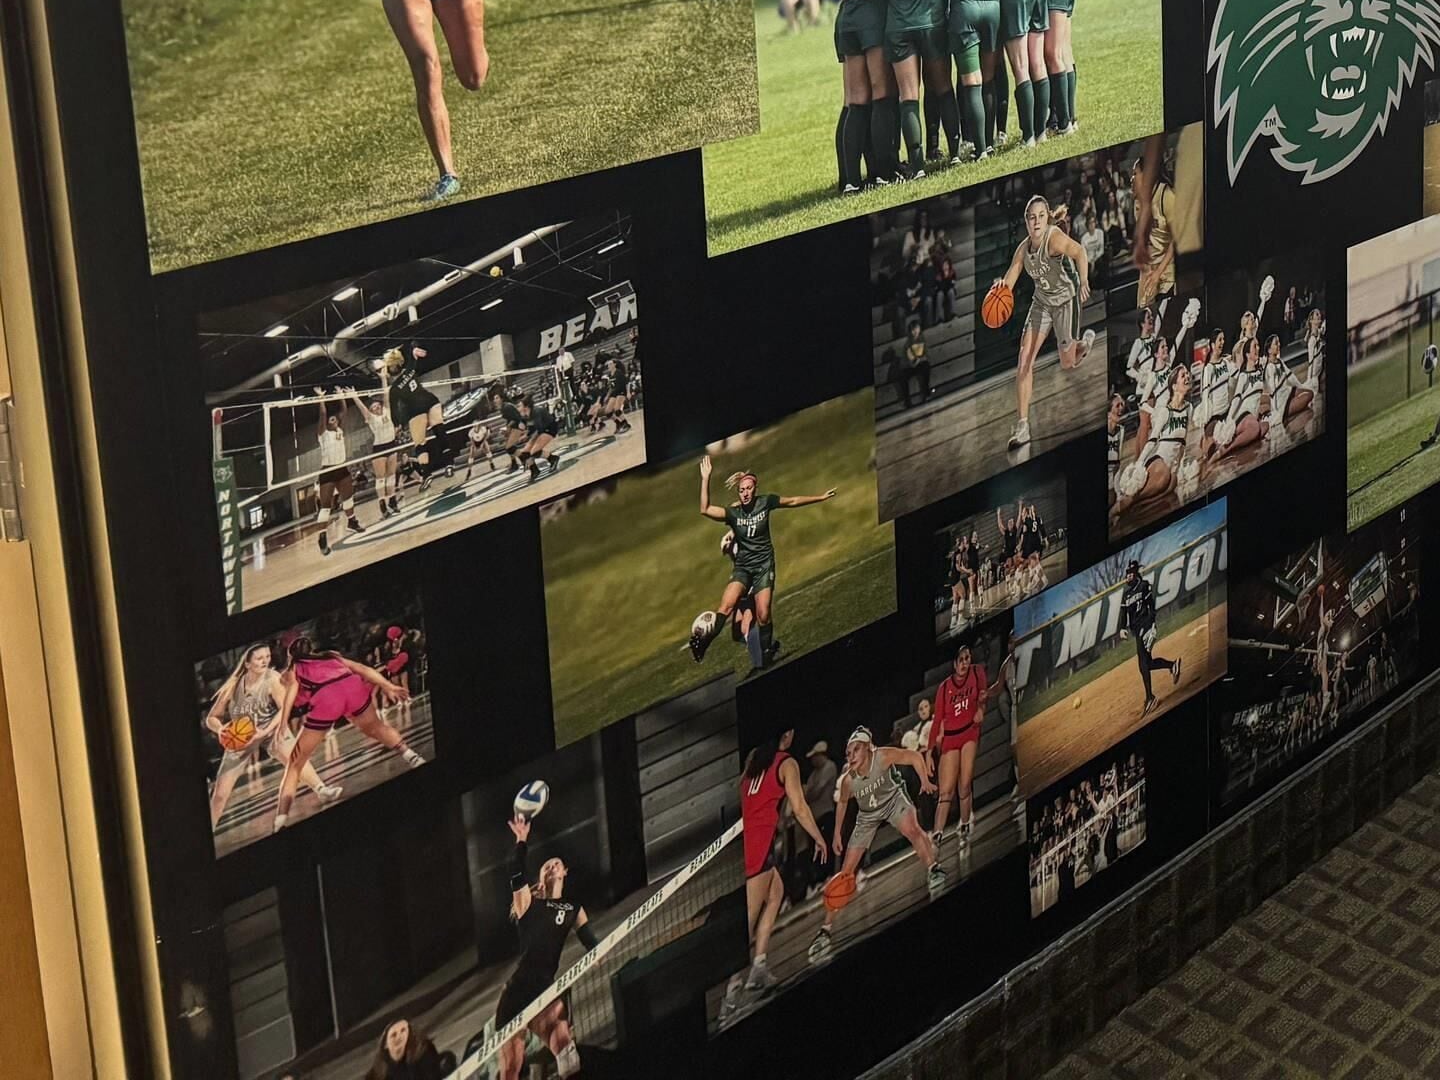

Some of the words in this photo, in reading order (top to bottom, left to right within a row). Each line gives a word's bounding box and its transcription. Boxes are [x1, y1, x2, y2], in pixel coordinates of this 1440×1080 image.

[1264, 116, 1277, 128] TM
[537, 293, 637, 359] BEAR
[747, 524, 757, 537] 17
[217, 489, 237, 617] NORTHWEST
[1056, 529, 1228, 668] MISO
[953, 698, 969, 717] 24
[869, 793, 878, 808] 4
[690, 838, 723, 873] BEARCATS
[555, 909, 566, 926] 8
[627, 890, 664, 929] BEARCATS
[556, 947, 598, 993] BEARCATS
[477, 1013, 523, 1060] BEARCATS
